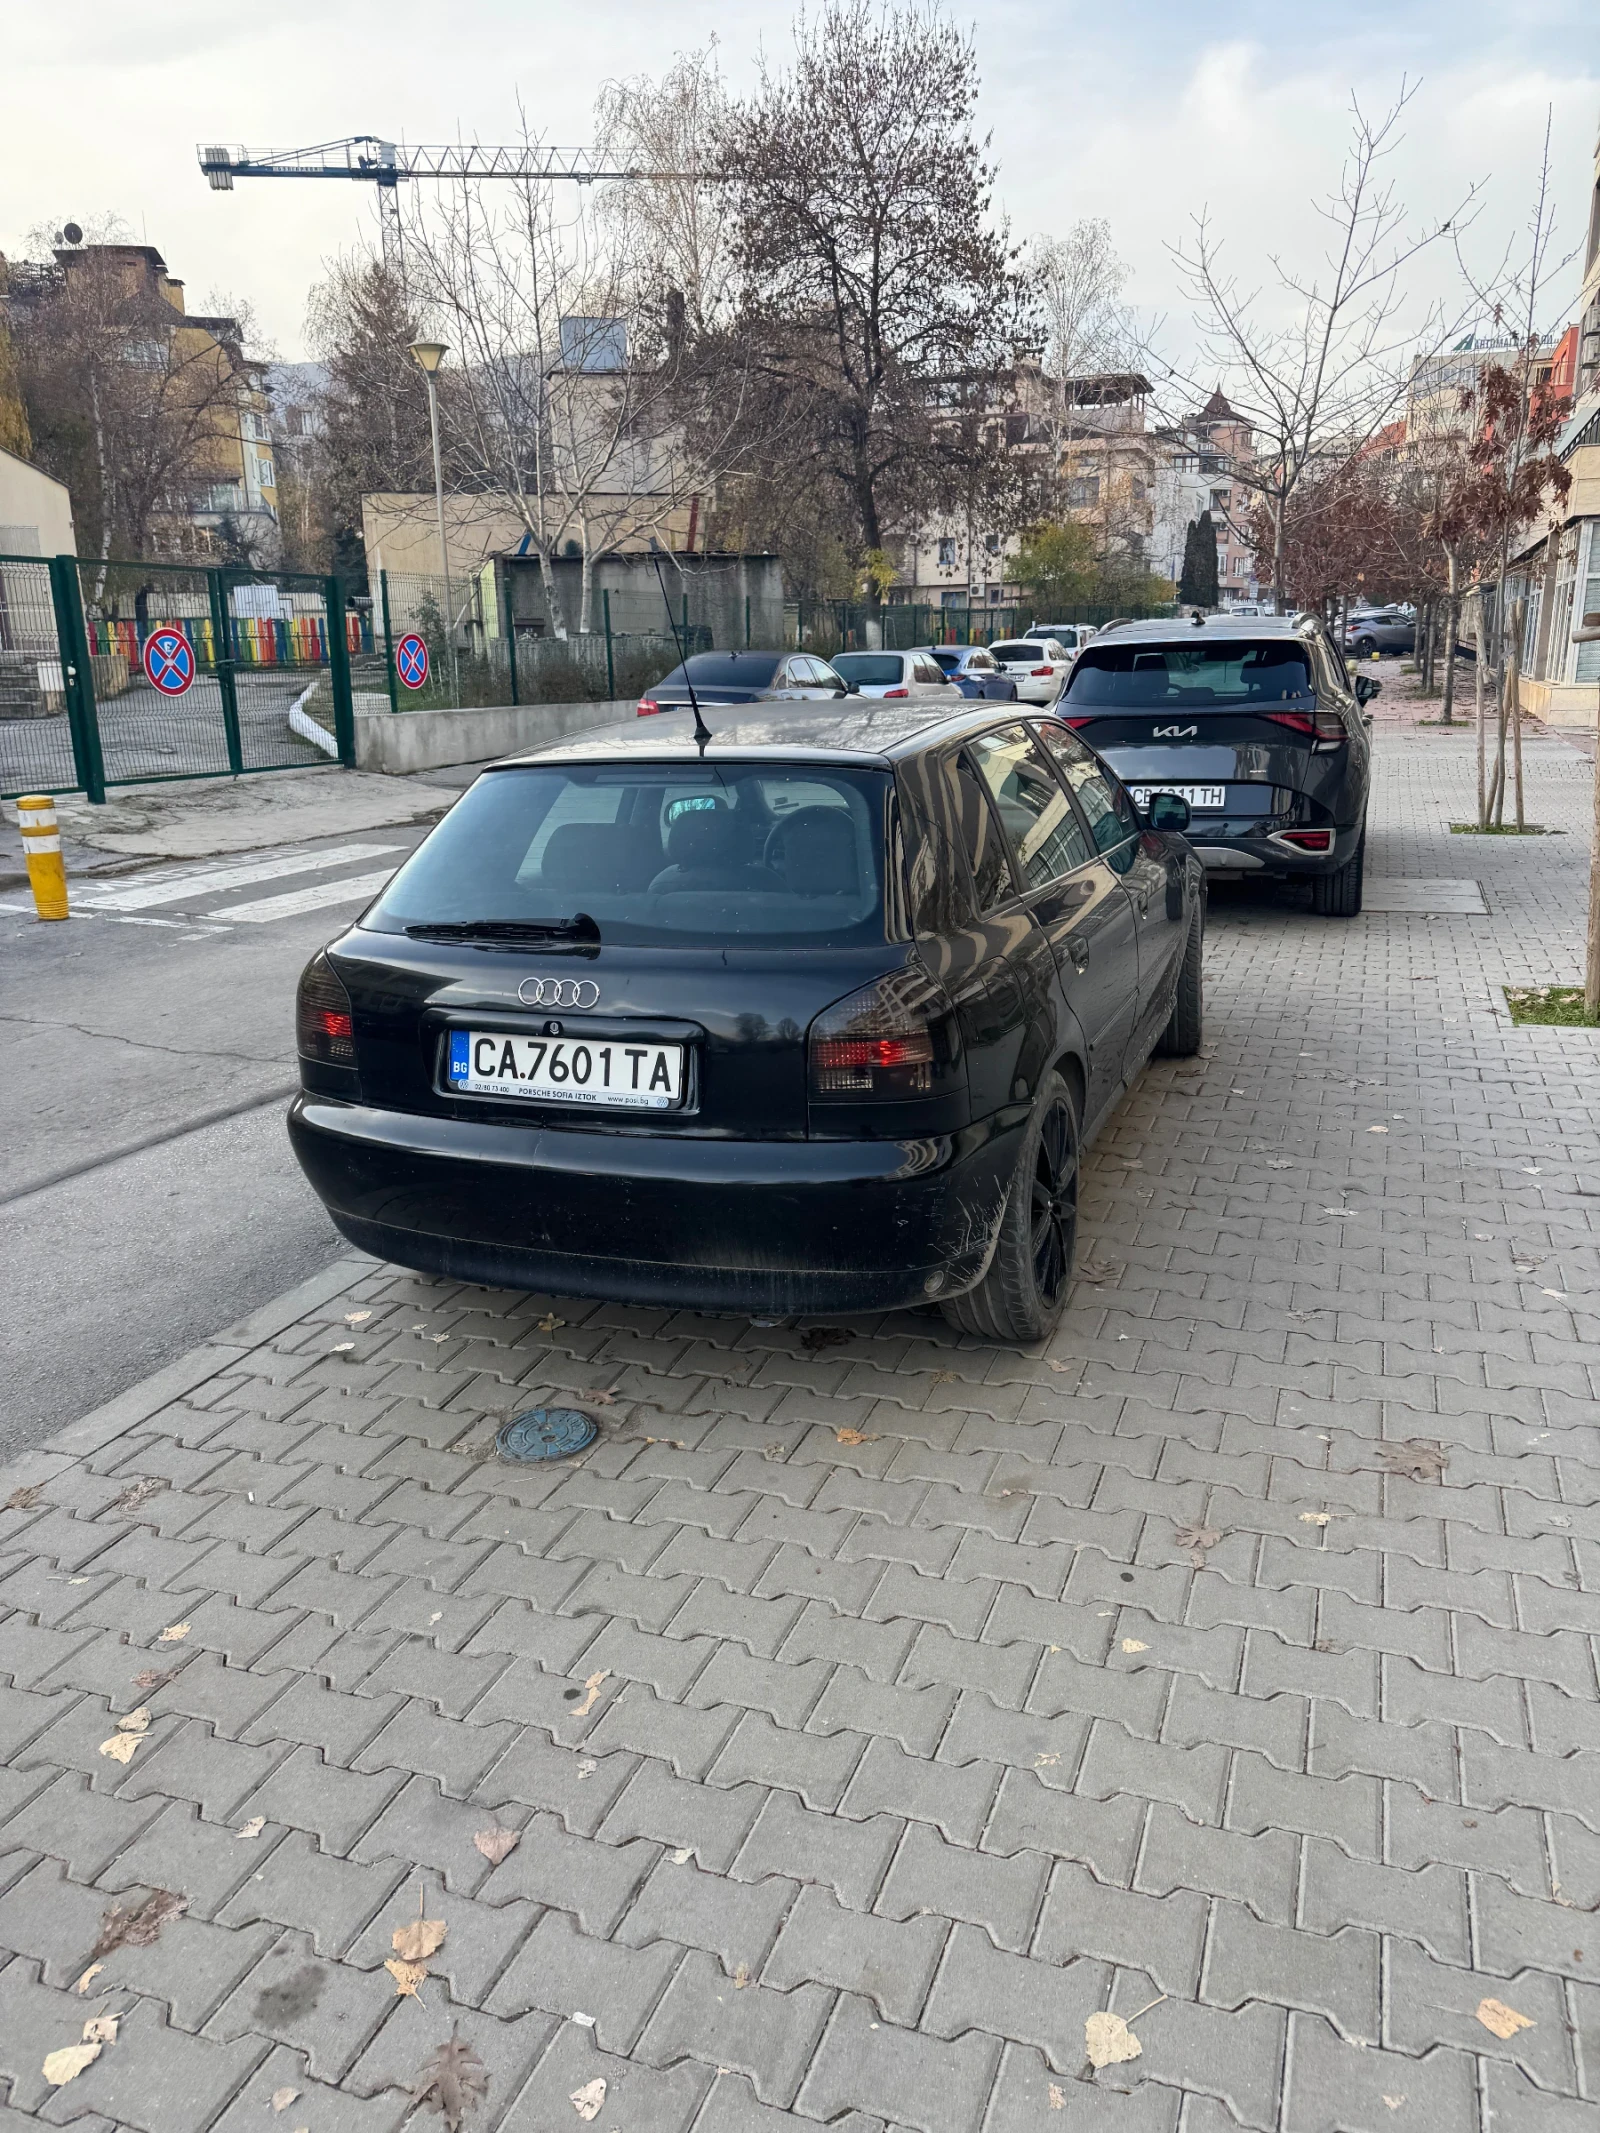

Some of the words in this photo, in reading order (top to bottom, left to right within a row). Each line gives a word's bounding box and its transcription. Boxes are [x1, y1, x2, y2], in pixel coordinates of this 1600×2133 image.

[453, 1062, 468, 1074] BG
[518, 1088, 551, 1097] PORSCHE
[552, 1091, 573, 1099] SOFIA
[575, 1093, 597, 1101] IZTOK
